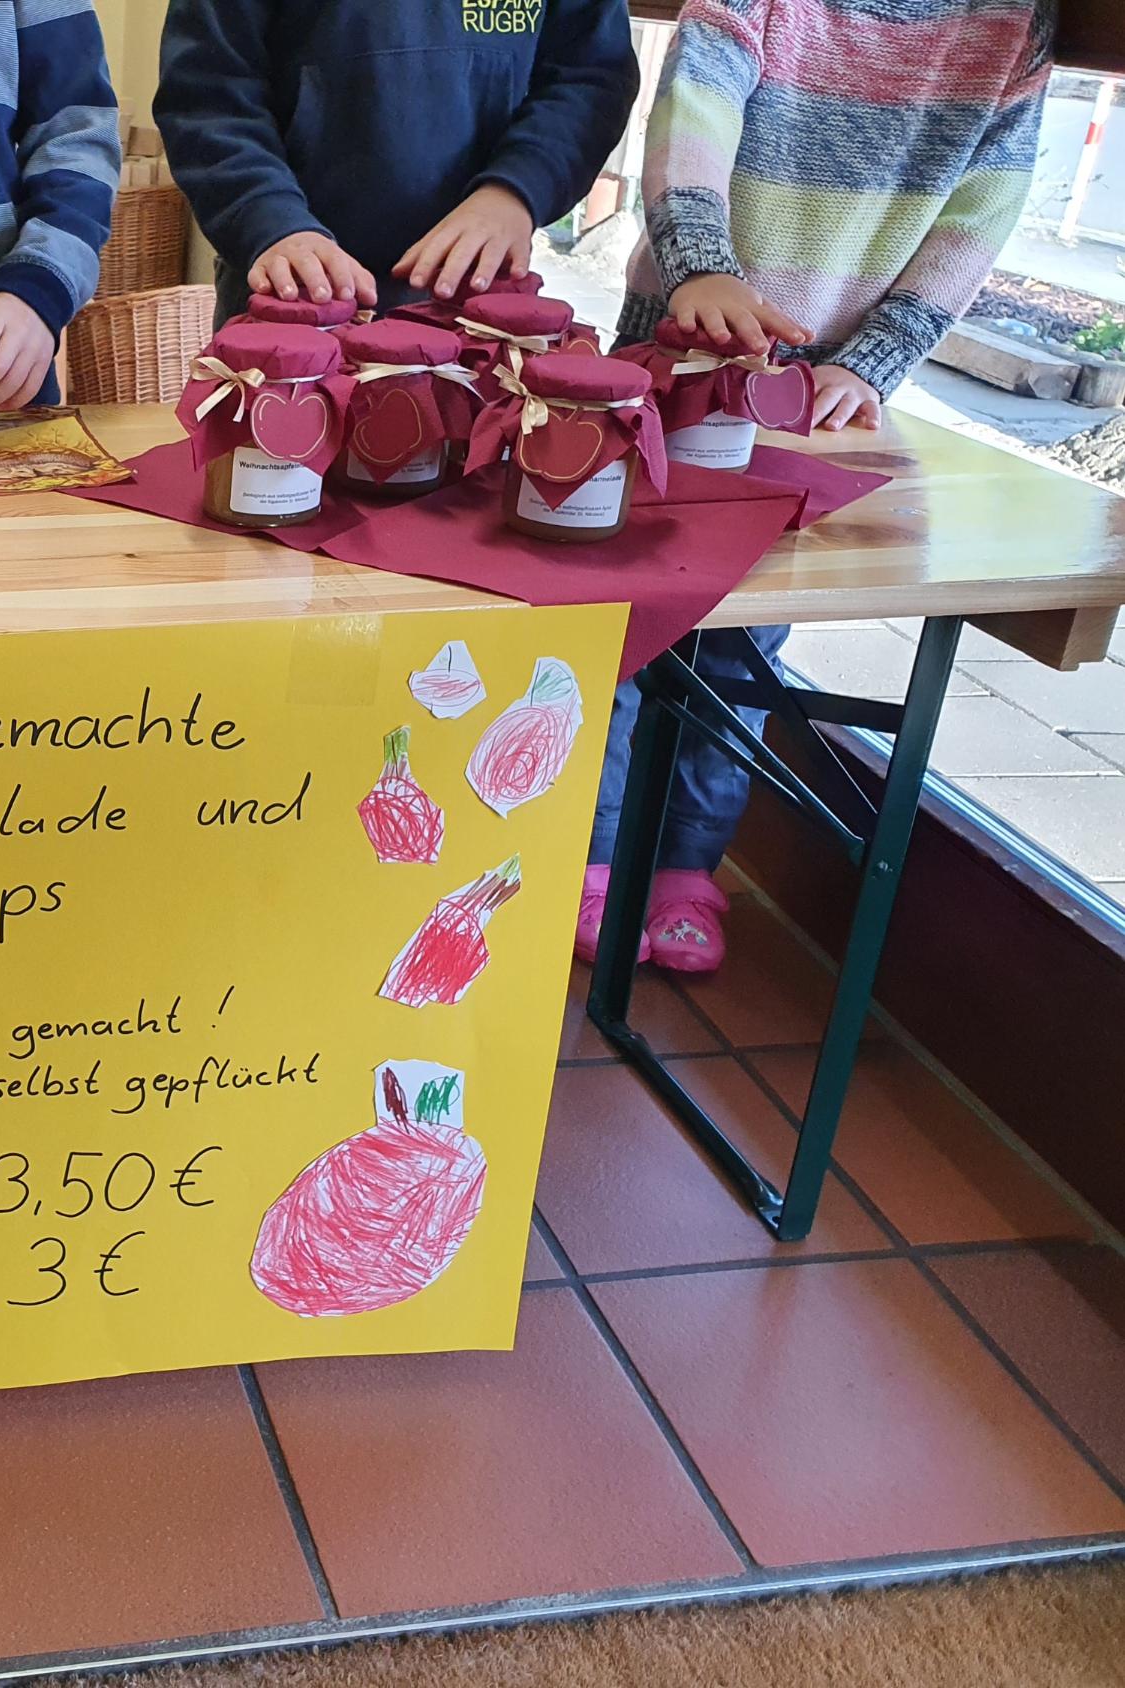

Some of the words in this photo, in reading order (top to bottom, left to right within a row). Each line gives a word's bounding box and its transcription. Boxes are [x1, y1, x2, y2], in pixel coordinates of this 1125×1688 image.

[463, 9, 541, 33] RUGBY
[197, 771, 311, 826] und
[111, 1053, 320, 1115] gepflückt
[7, 1237, 67, 1306] 3
[93, 1230, 145, 1296] €
